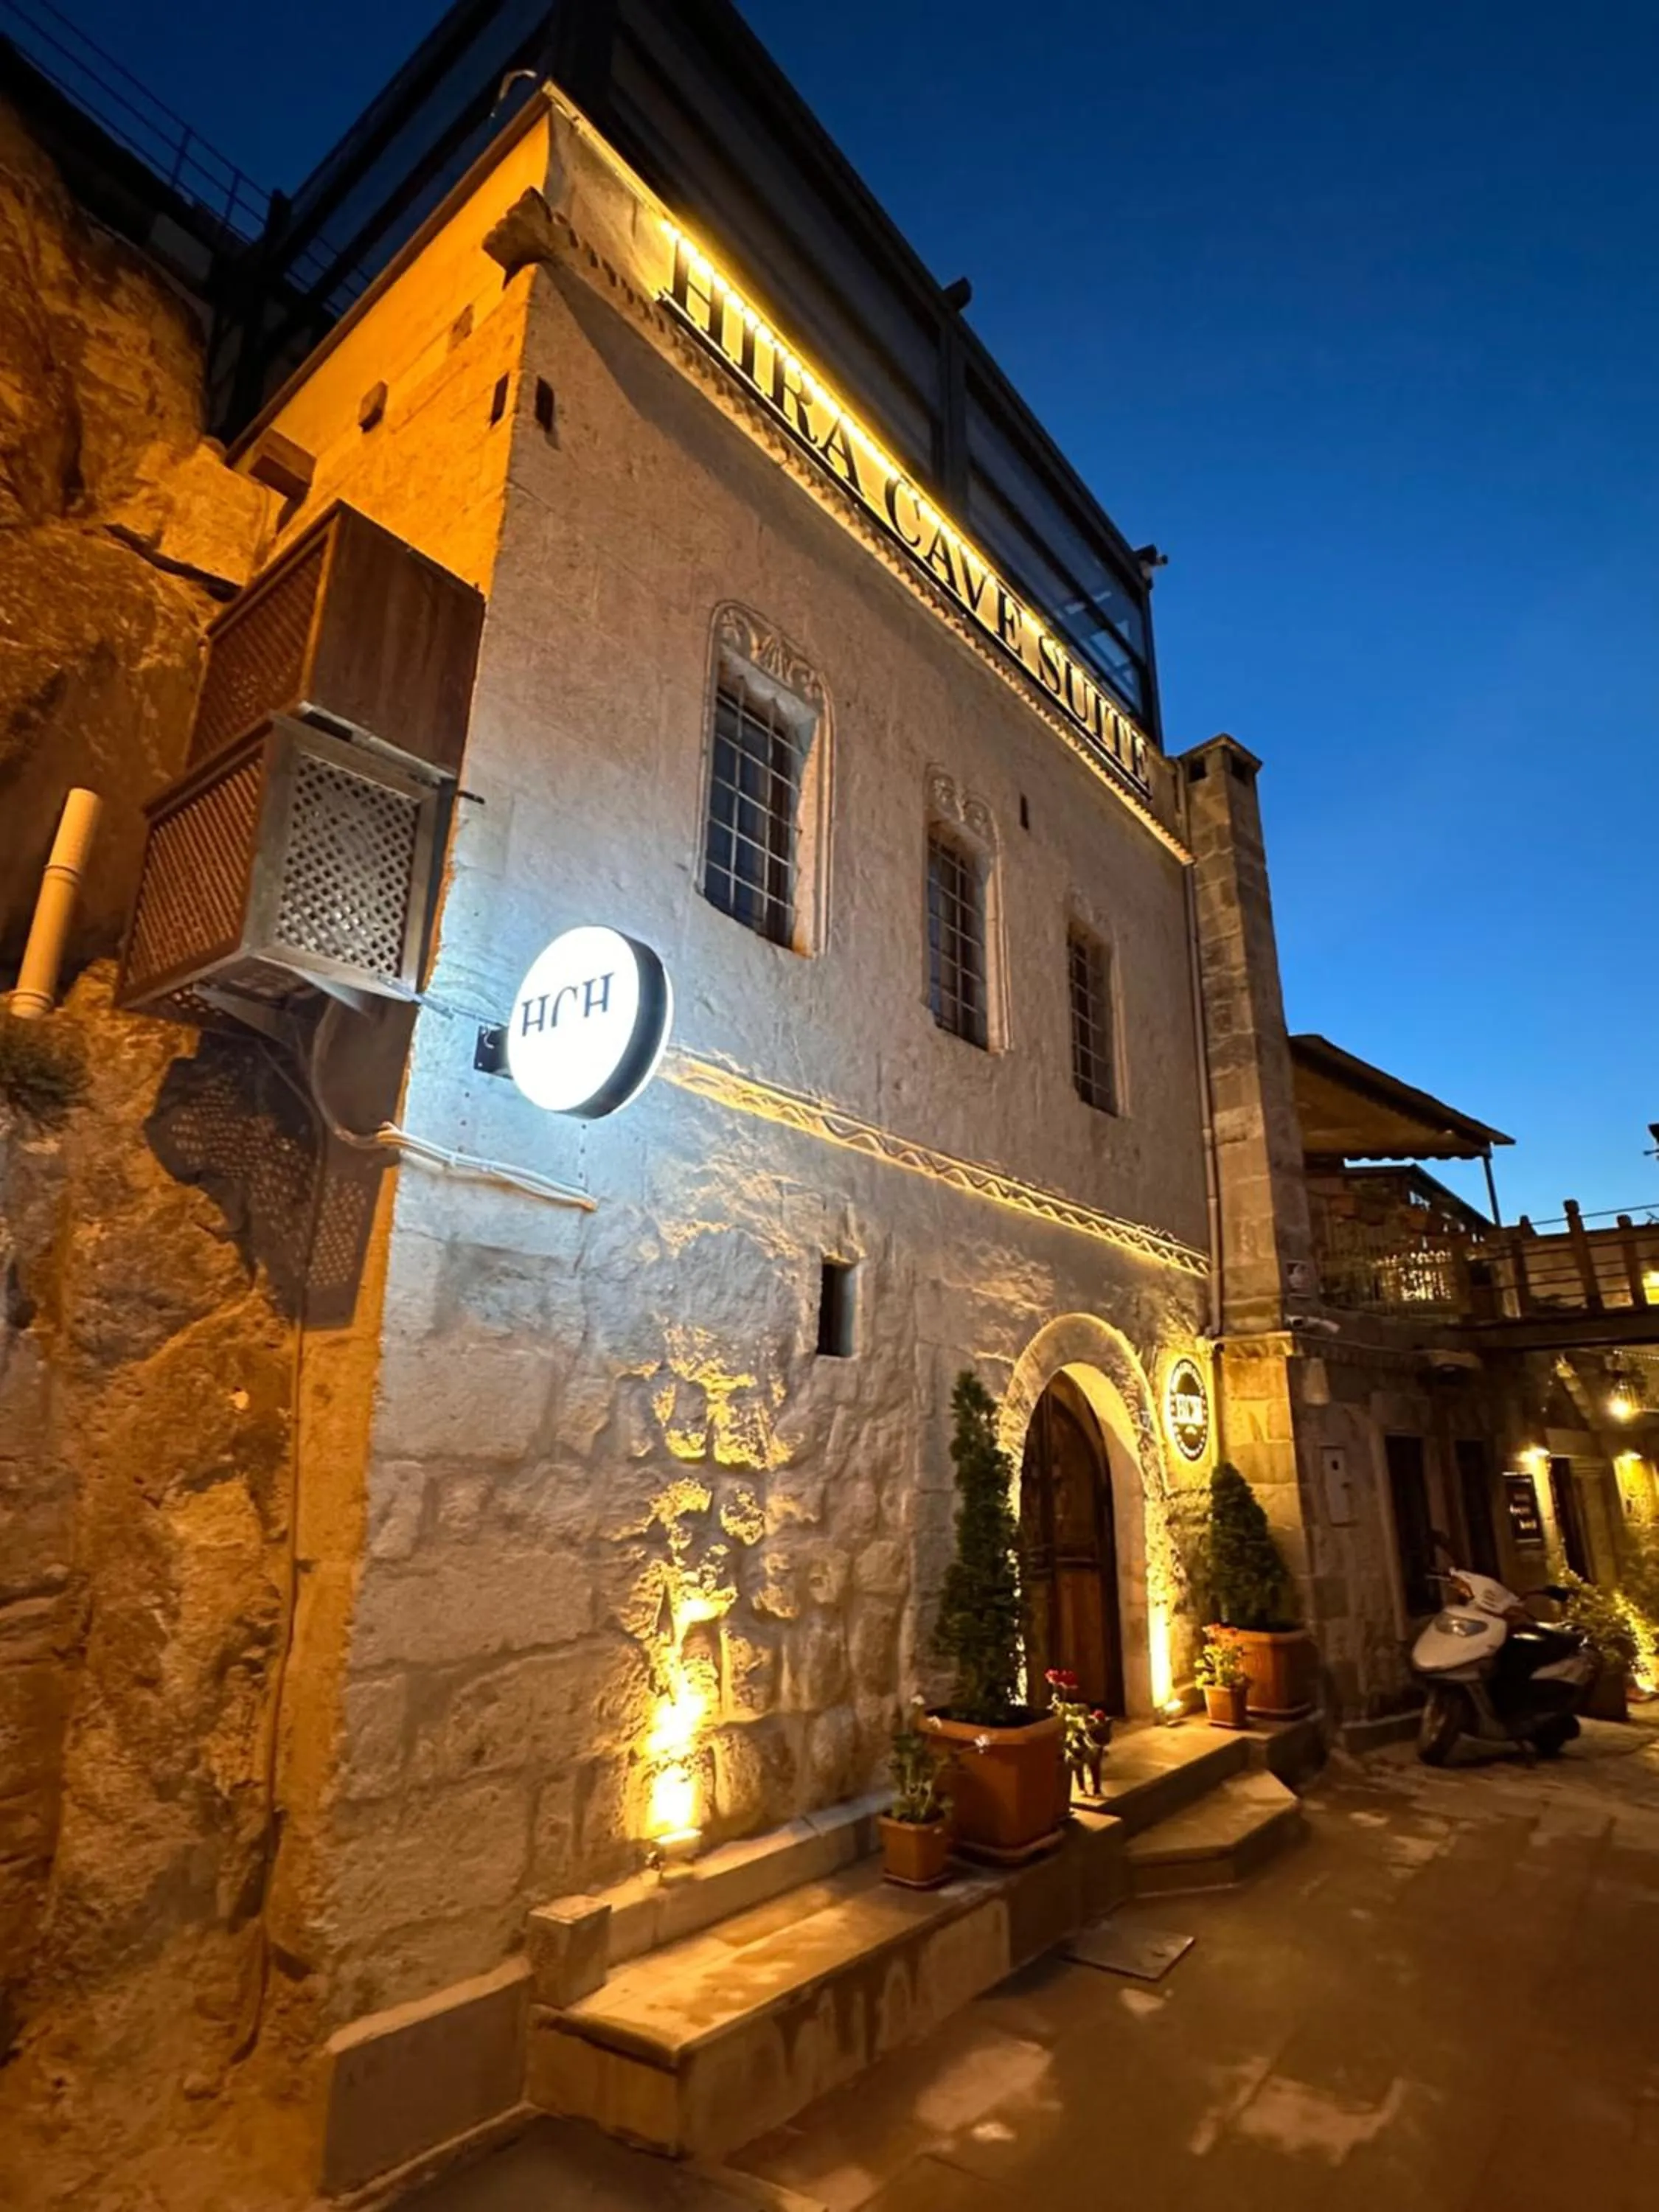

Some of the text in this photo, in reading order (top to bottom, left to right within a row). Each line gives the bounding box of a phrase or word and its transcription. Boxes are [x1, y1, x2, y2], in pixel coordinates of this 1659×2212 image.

[661, 234, 1150, 792] HIRA CAVE SUITE
[521, 972, 614, 1037] HCH
